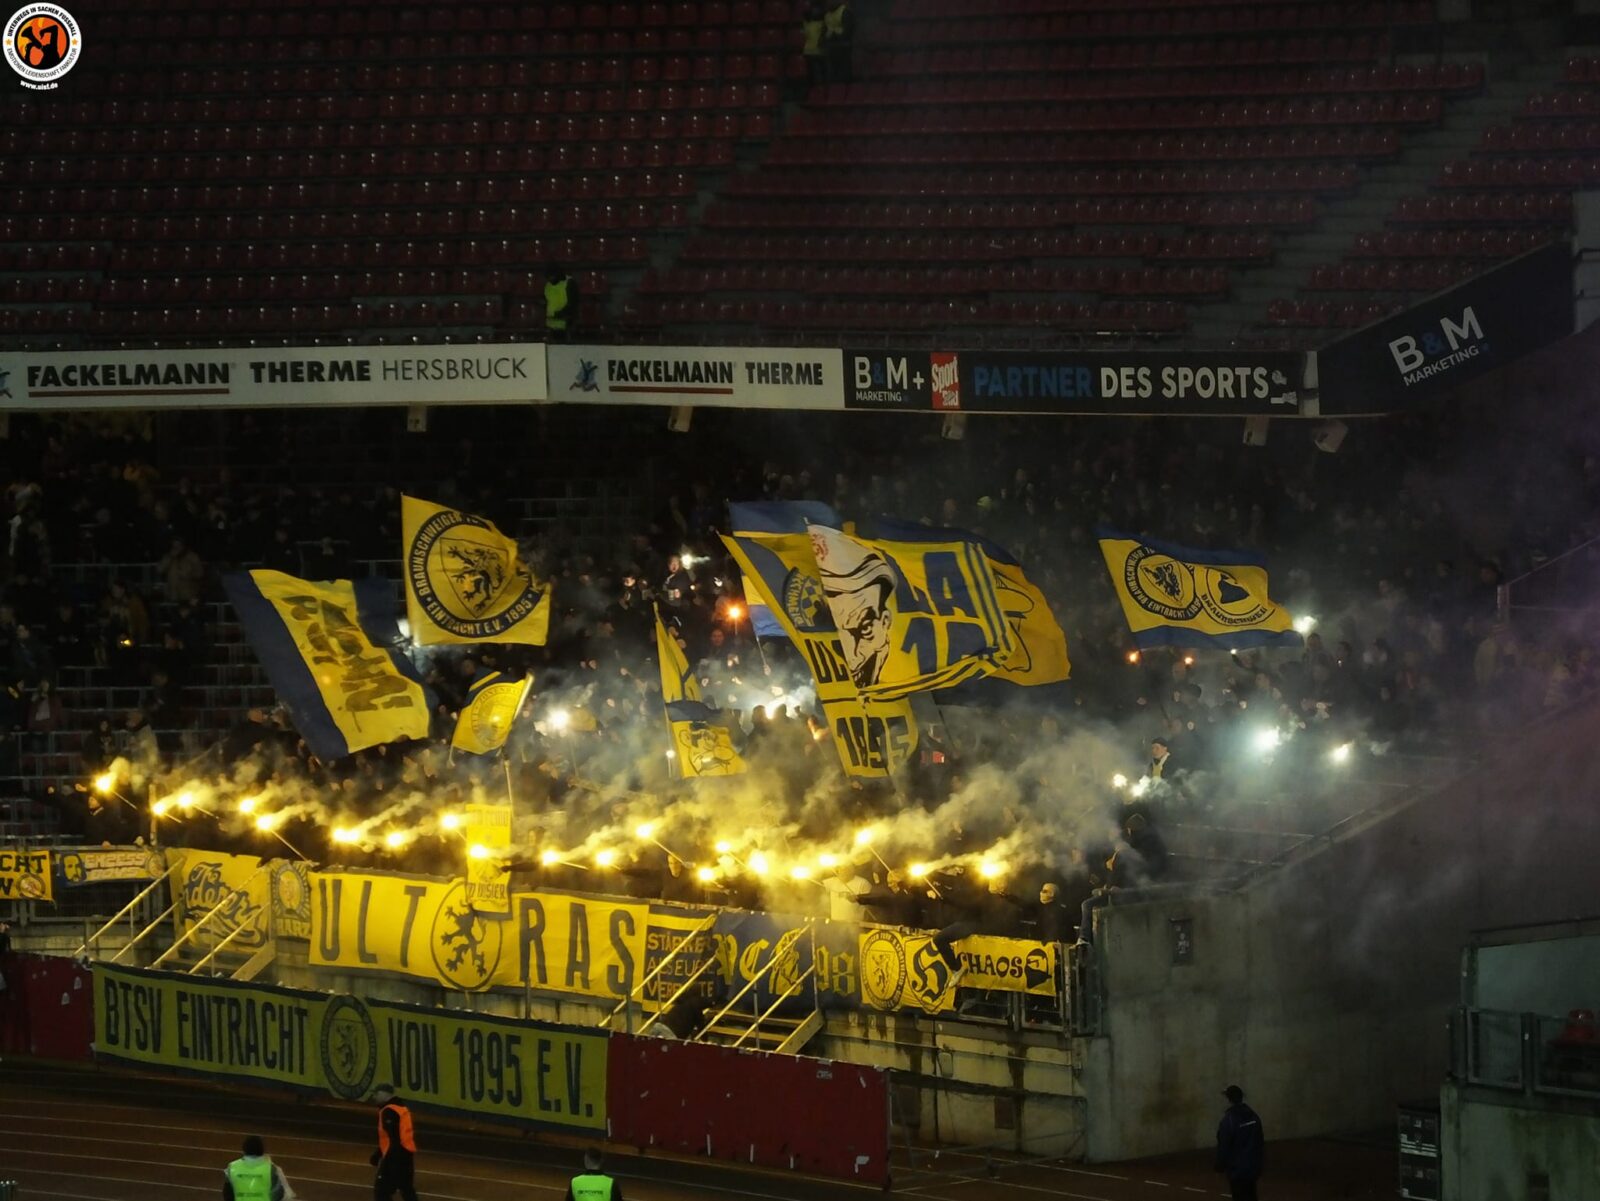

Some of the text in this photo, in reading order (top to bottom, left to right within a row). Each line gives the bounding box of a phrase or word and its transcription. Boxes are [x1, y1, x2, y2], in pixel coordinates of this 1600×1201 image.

[1388, 305, 1484, 375] B&M
[27, 357, 527, 388] FACKELMANN THERME HERSBRUCK
[608, 360, 824, 387] FACKELMANN THERME
[854, 356, 908, 391] B&M
[931, 355, 959, 393] Sport
[973, 365, 1270, 399] PARTNER DES SPORTS
[1402, 345, 1480, 387] MARKETING
[855, 390, 903, 402] MARKETING
[505, 598, 533, 624] 1895
[1148, 600, 1186, 619] EINTRACHT
[103, 976, 163, 1054] BTSV
[175, 989, 309, 1076] EINTRACHT
[387, 1016, 439, 1095] VON
[452, 1027, 523, 1107] 1895
[536, 1037, 594, 1118] E.V.
